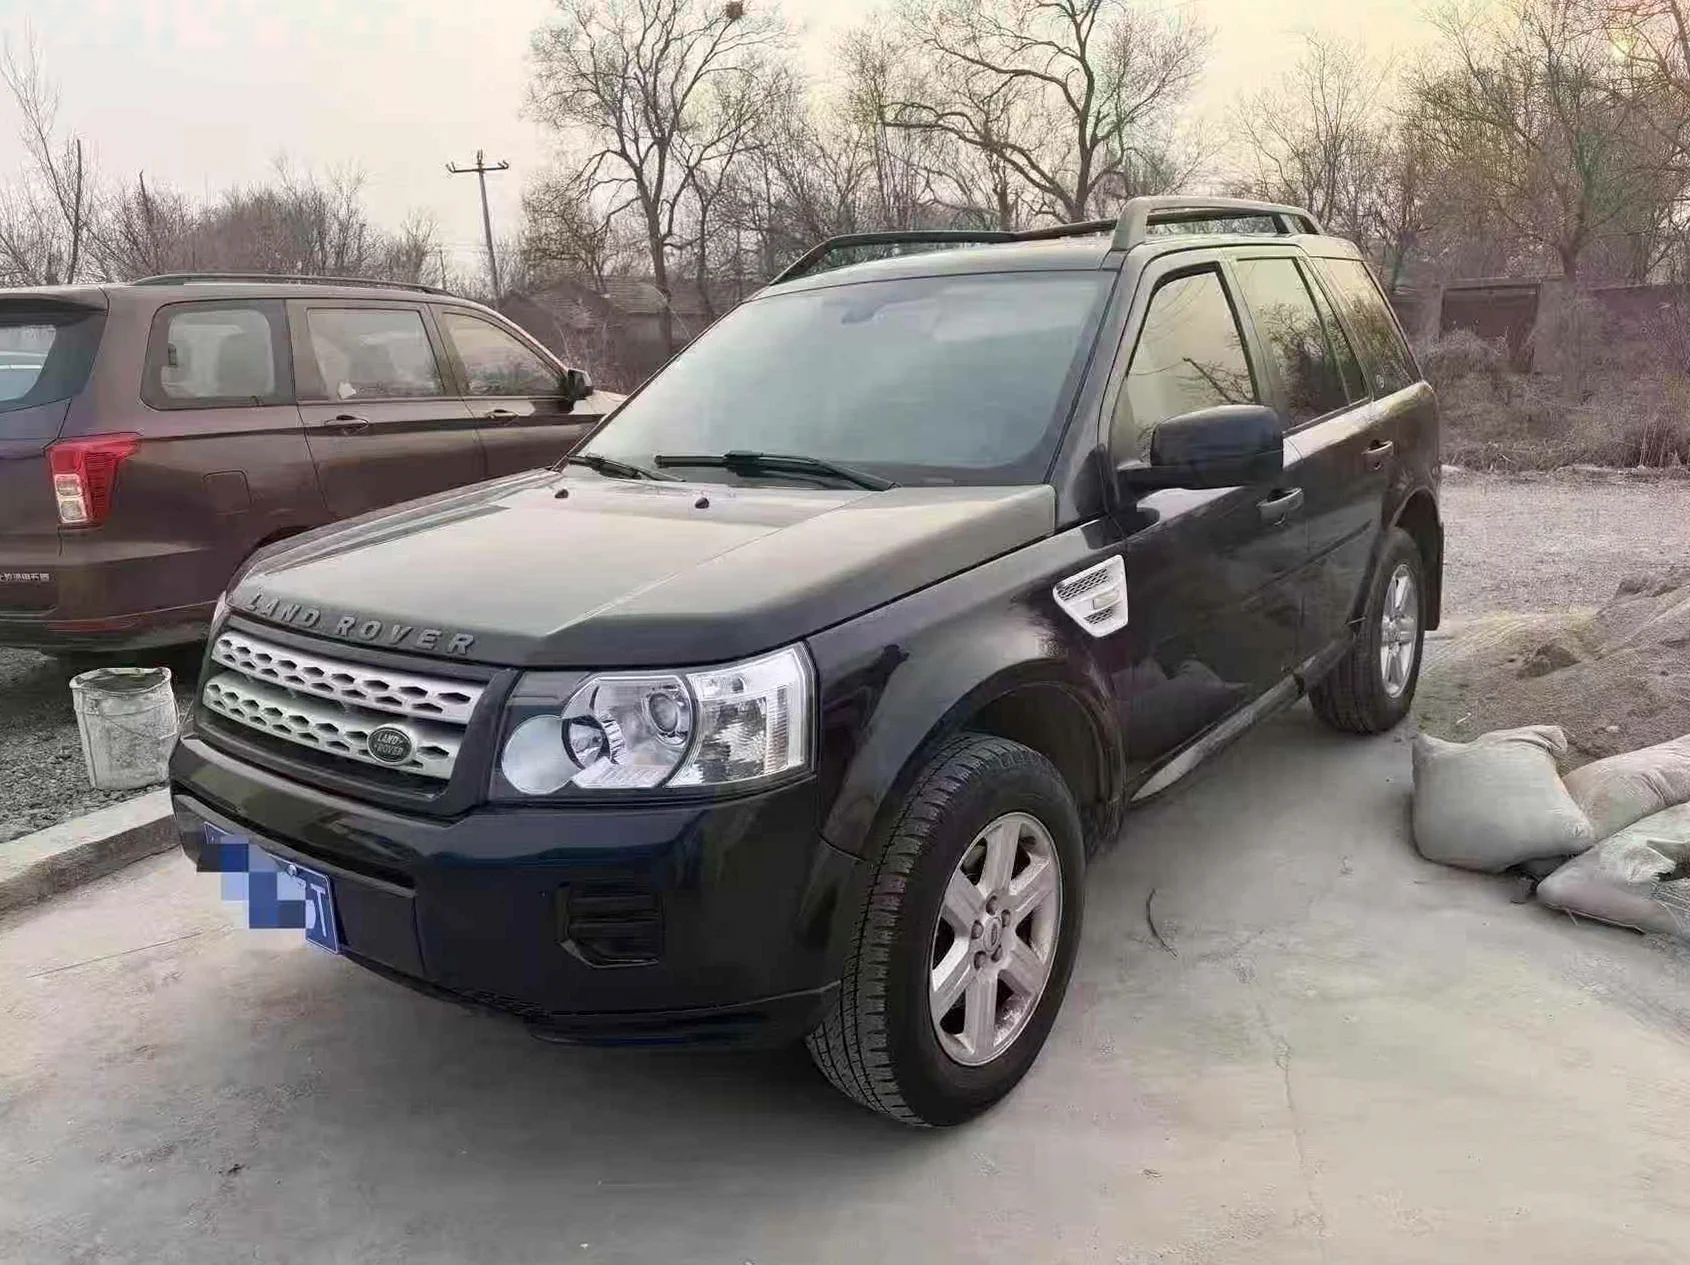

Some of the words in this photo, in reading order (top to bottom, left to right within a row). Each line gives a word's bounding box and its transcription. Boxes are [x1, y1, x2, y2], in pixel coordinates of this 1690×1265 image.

[246, 593, 321, 627] LAND
[335, 615, 475, 656] ROVER
[377, 732, 400, 745] LAND
[376, 742, 404, 756] ROVER
